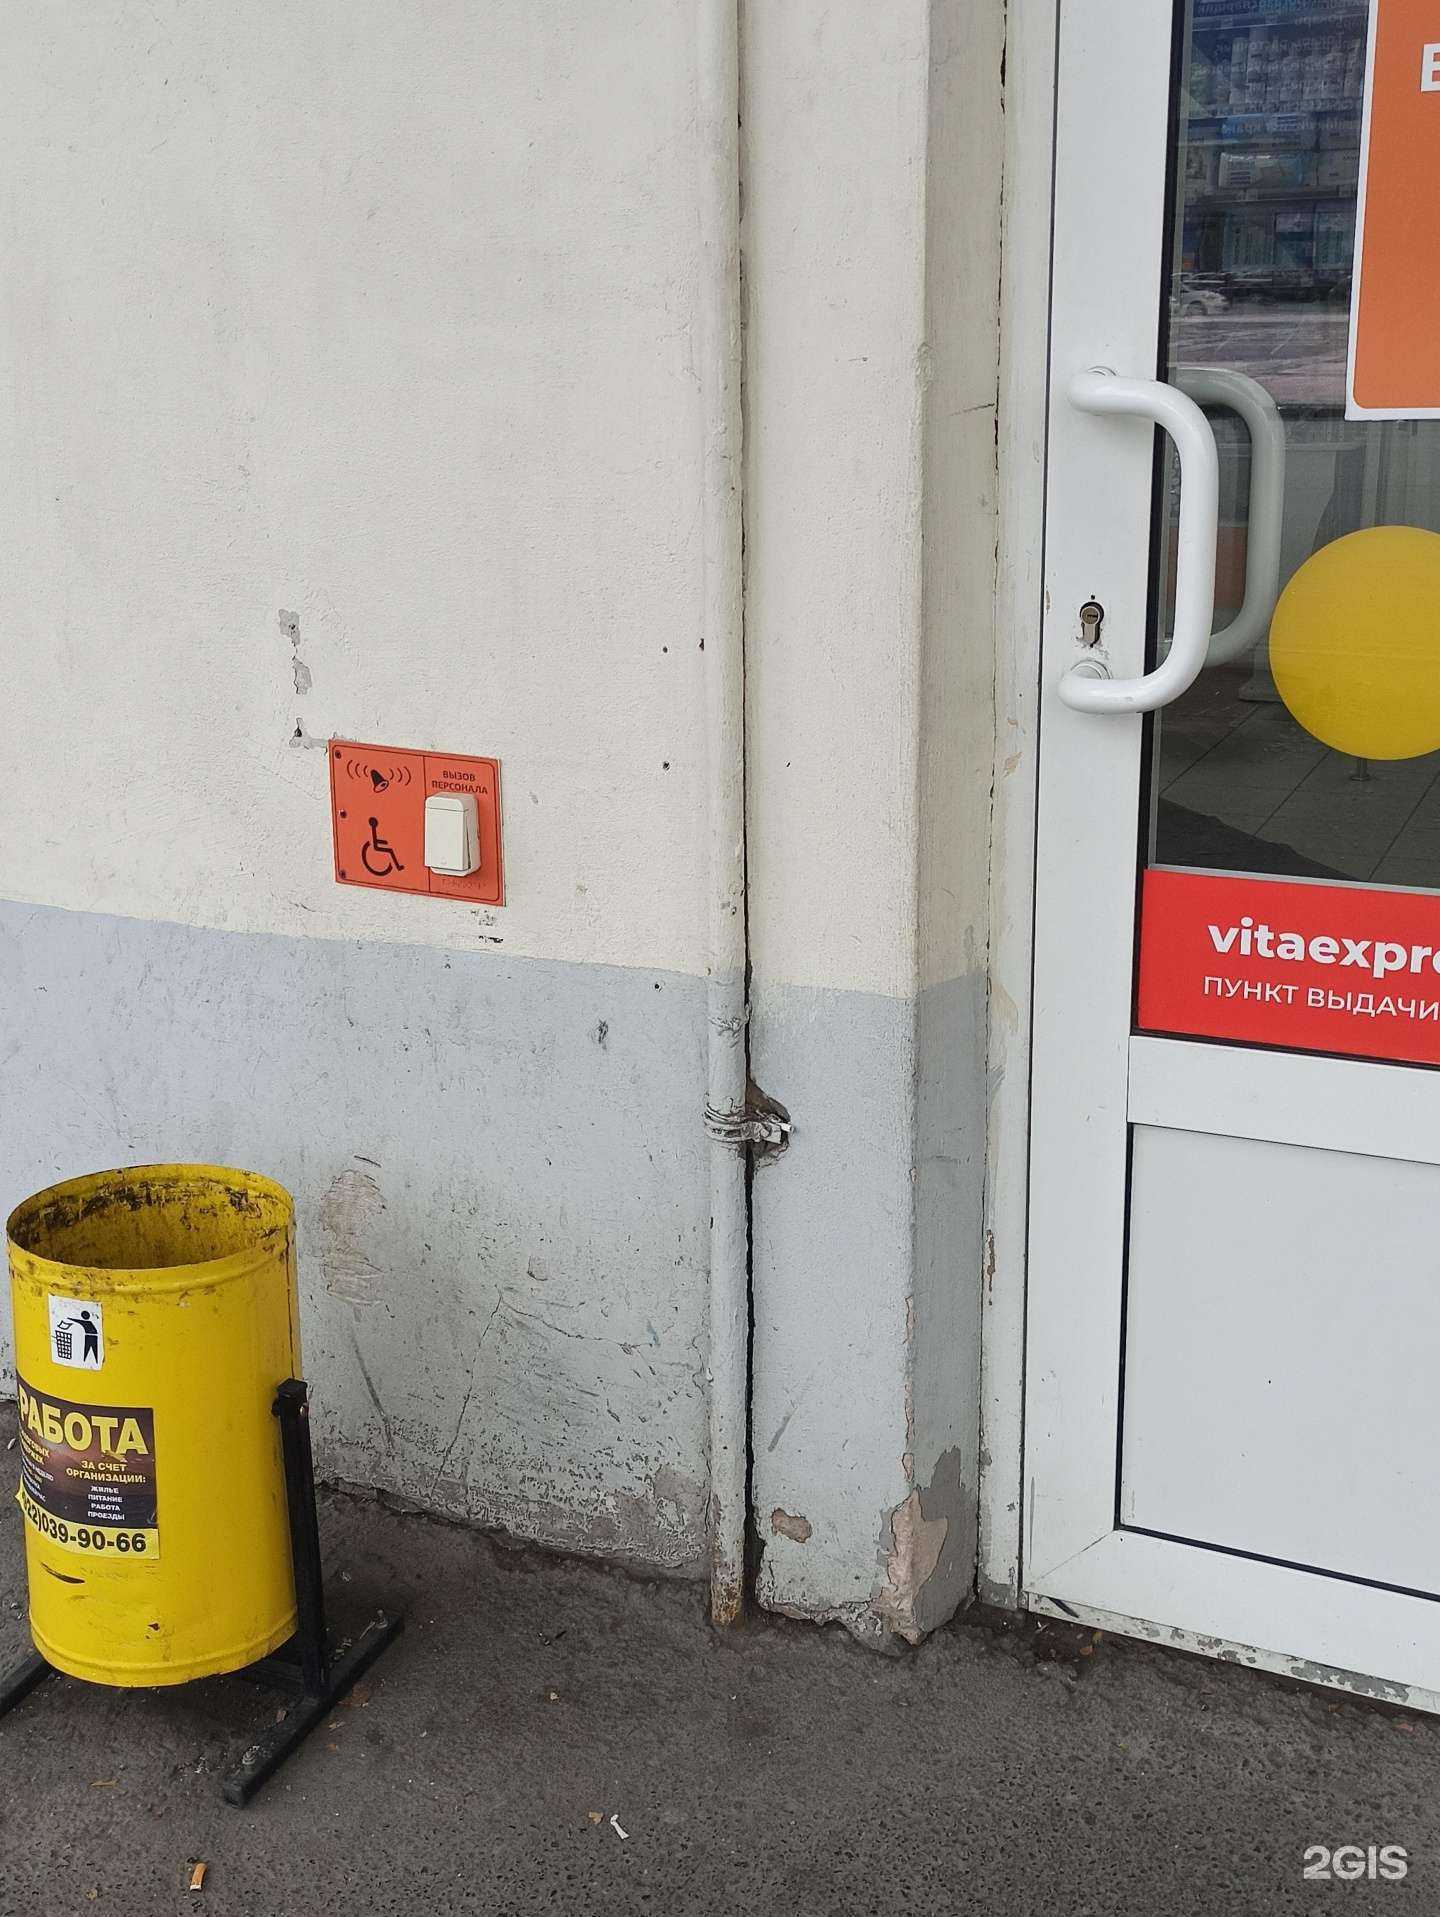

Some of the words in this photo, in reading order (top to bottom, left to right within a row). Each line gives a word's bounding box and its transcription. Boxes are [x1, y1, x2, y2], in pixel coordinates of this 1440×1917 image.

[442, 770, 476, 782] ВЫЗОВ
[431, 780, 488, 794] ПЕРСОНАЛА
[1207, 916, 1440, 978] vitaexpr
[1203, 976, 1299, 1004] ПУНКТ
[1306, 987, 1440, 1021] ВЫДАЧИ
[18, 1383, 149, 1455] РАБОТА
[81, 1460, 95, 1470] ЗА
[97, 1462, 128, 1472] СЧЕТ
[65, 1467, 147, 1485] ОРГАНИЗАЦИИ:
[90, 1485, 120, 1494] ЖИЛЬЕ
[87, 1493, 123, 1503] ПИТАНИЕ
[90, 1502, 121, 1512] РАБОТА
[87, 1510, 126, 1521] ПРОЕЗДЫ
